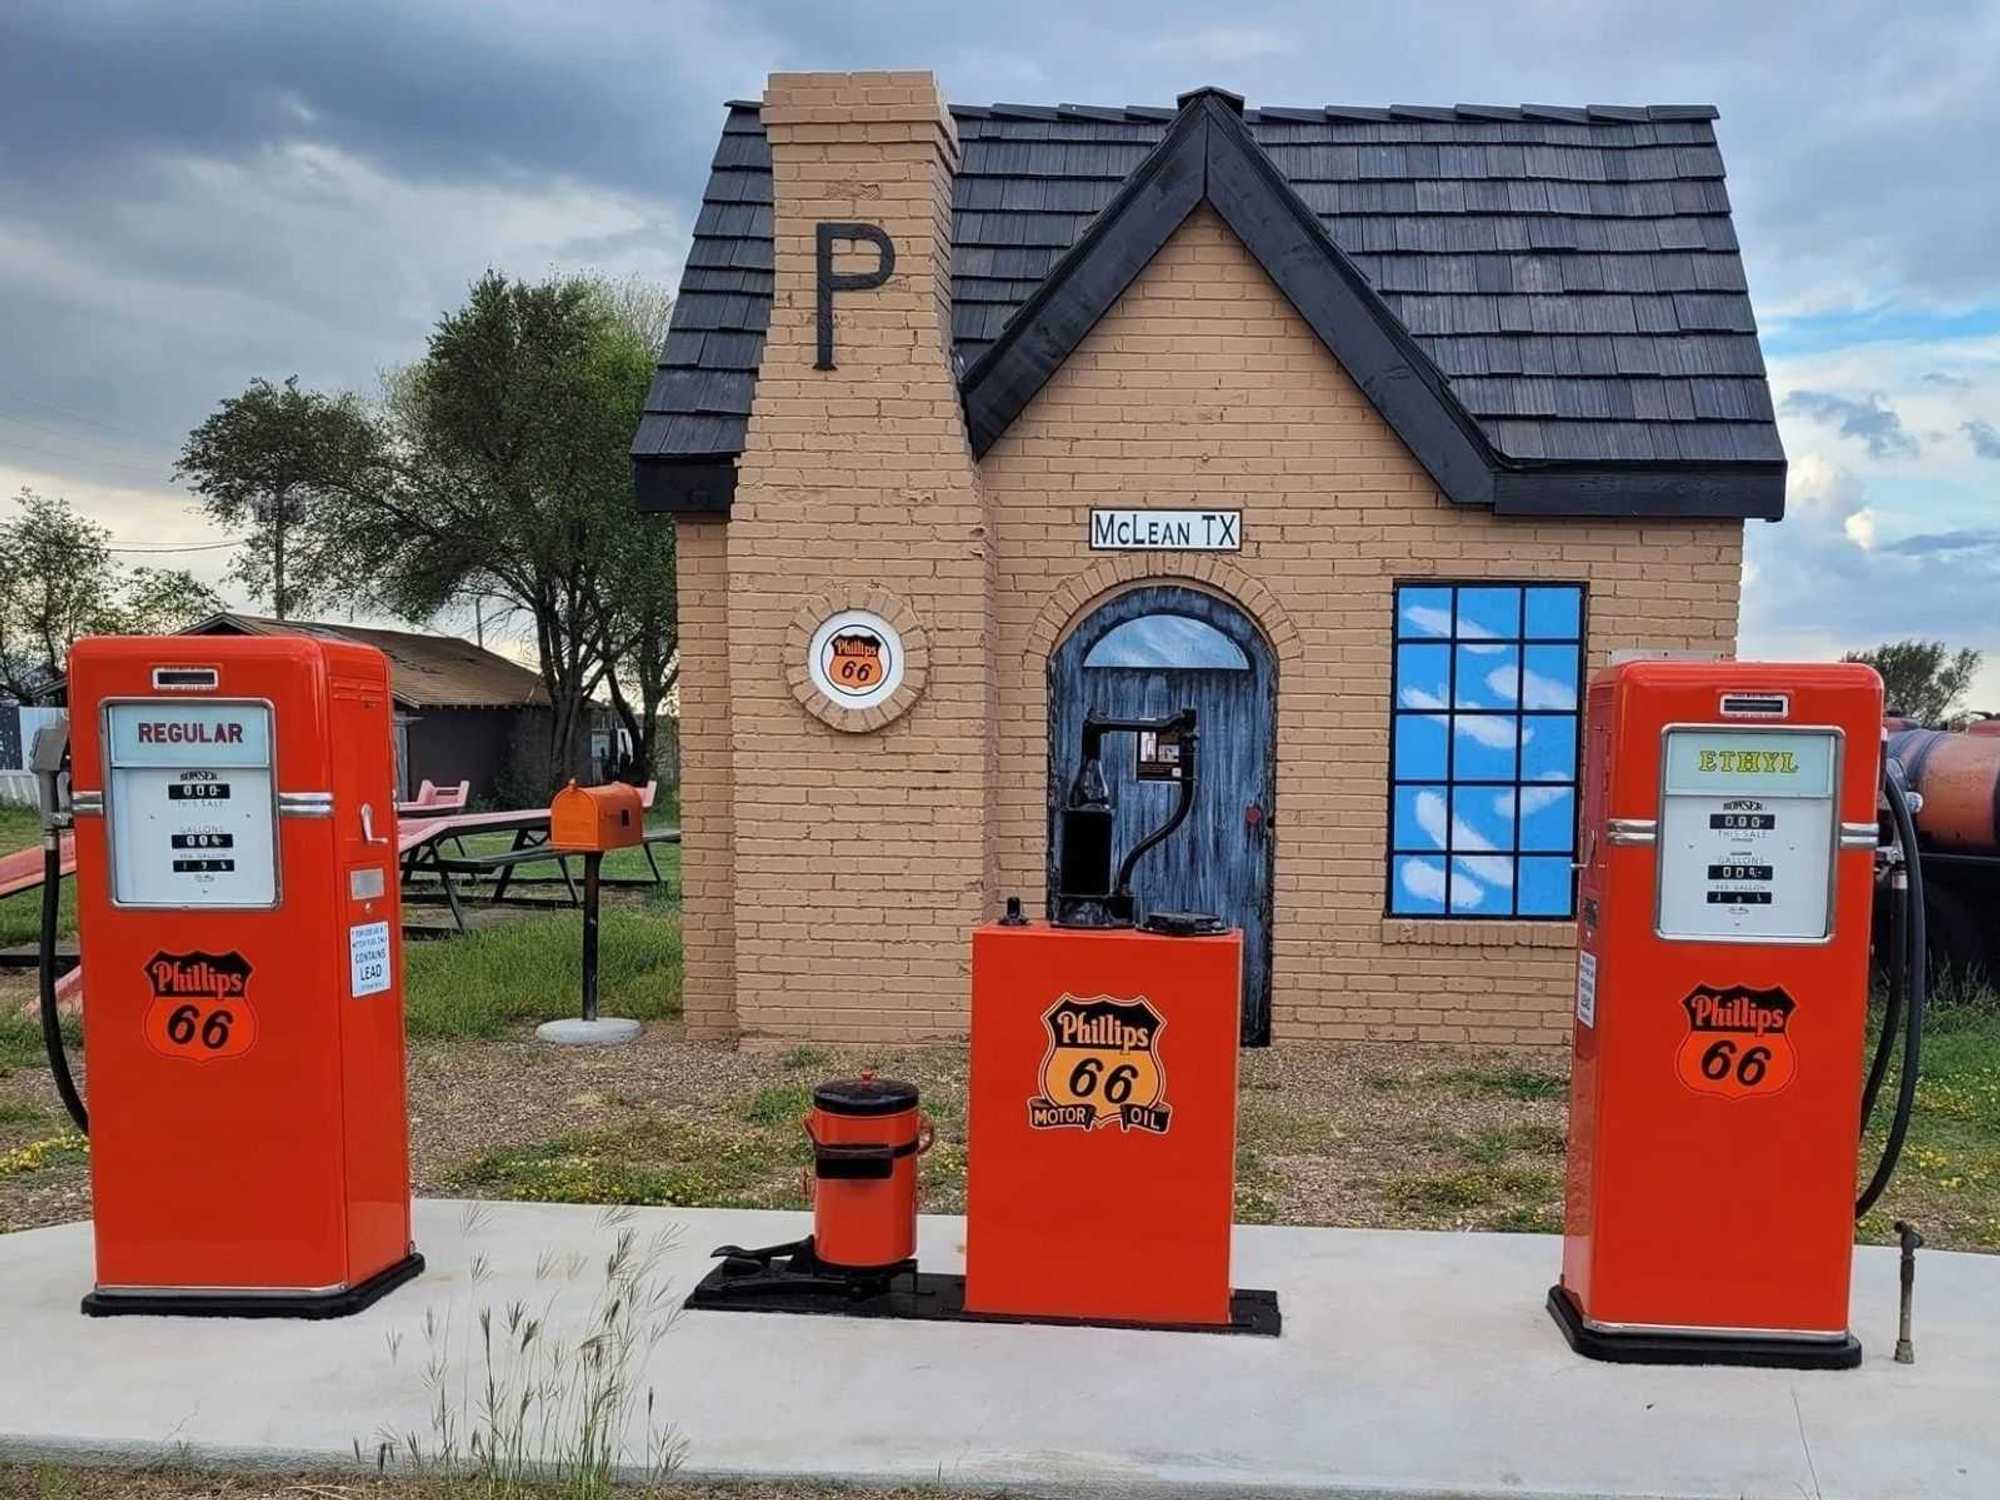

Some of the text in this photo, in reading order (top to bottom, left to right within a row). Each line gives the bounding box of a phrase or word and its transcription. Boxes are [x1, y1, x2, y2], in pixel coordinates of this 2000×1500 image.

[813, 222, 896, 371] P
[1202, 514, 1237, 546] TX
[834, 639, 877, 657] Phillips
[842, 660, 873, 682] 66
[138, 722, 244, 744] REGULAR
[1698, 750, 1800, 774] ETHYL
[152, 960, 243, 1001] Phillips
[360, 964, 382, 981] LEAD
[168, 1004, 234, 1050] 66
[1057, 1010, 1150, 1055] Phillips
[1691, 994, 1785, 1037] Phillips
[1069, 1057, 1140, 1105] 66
[1702, 1040, 1772, 1087] 66
[1033, 1106, 1161, 1131] MOTOR OIL
